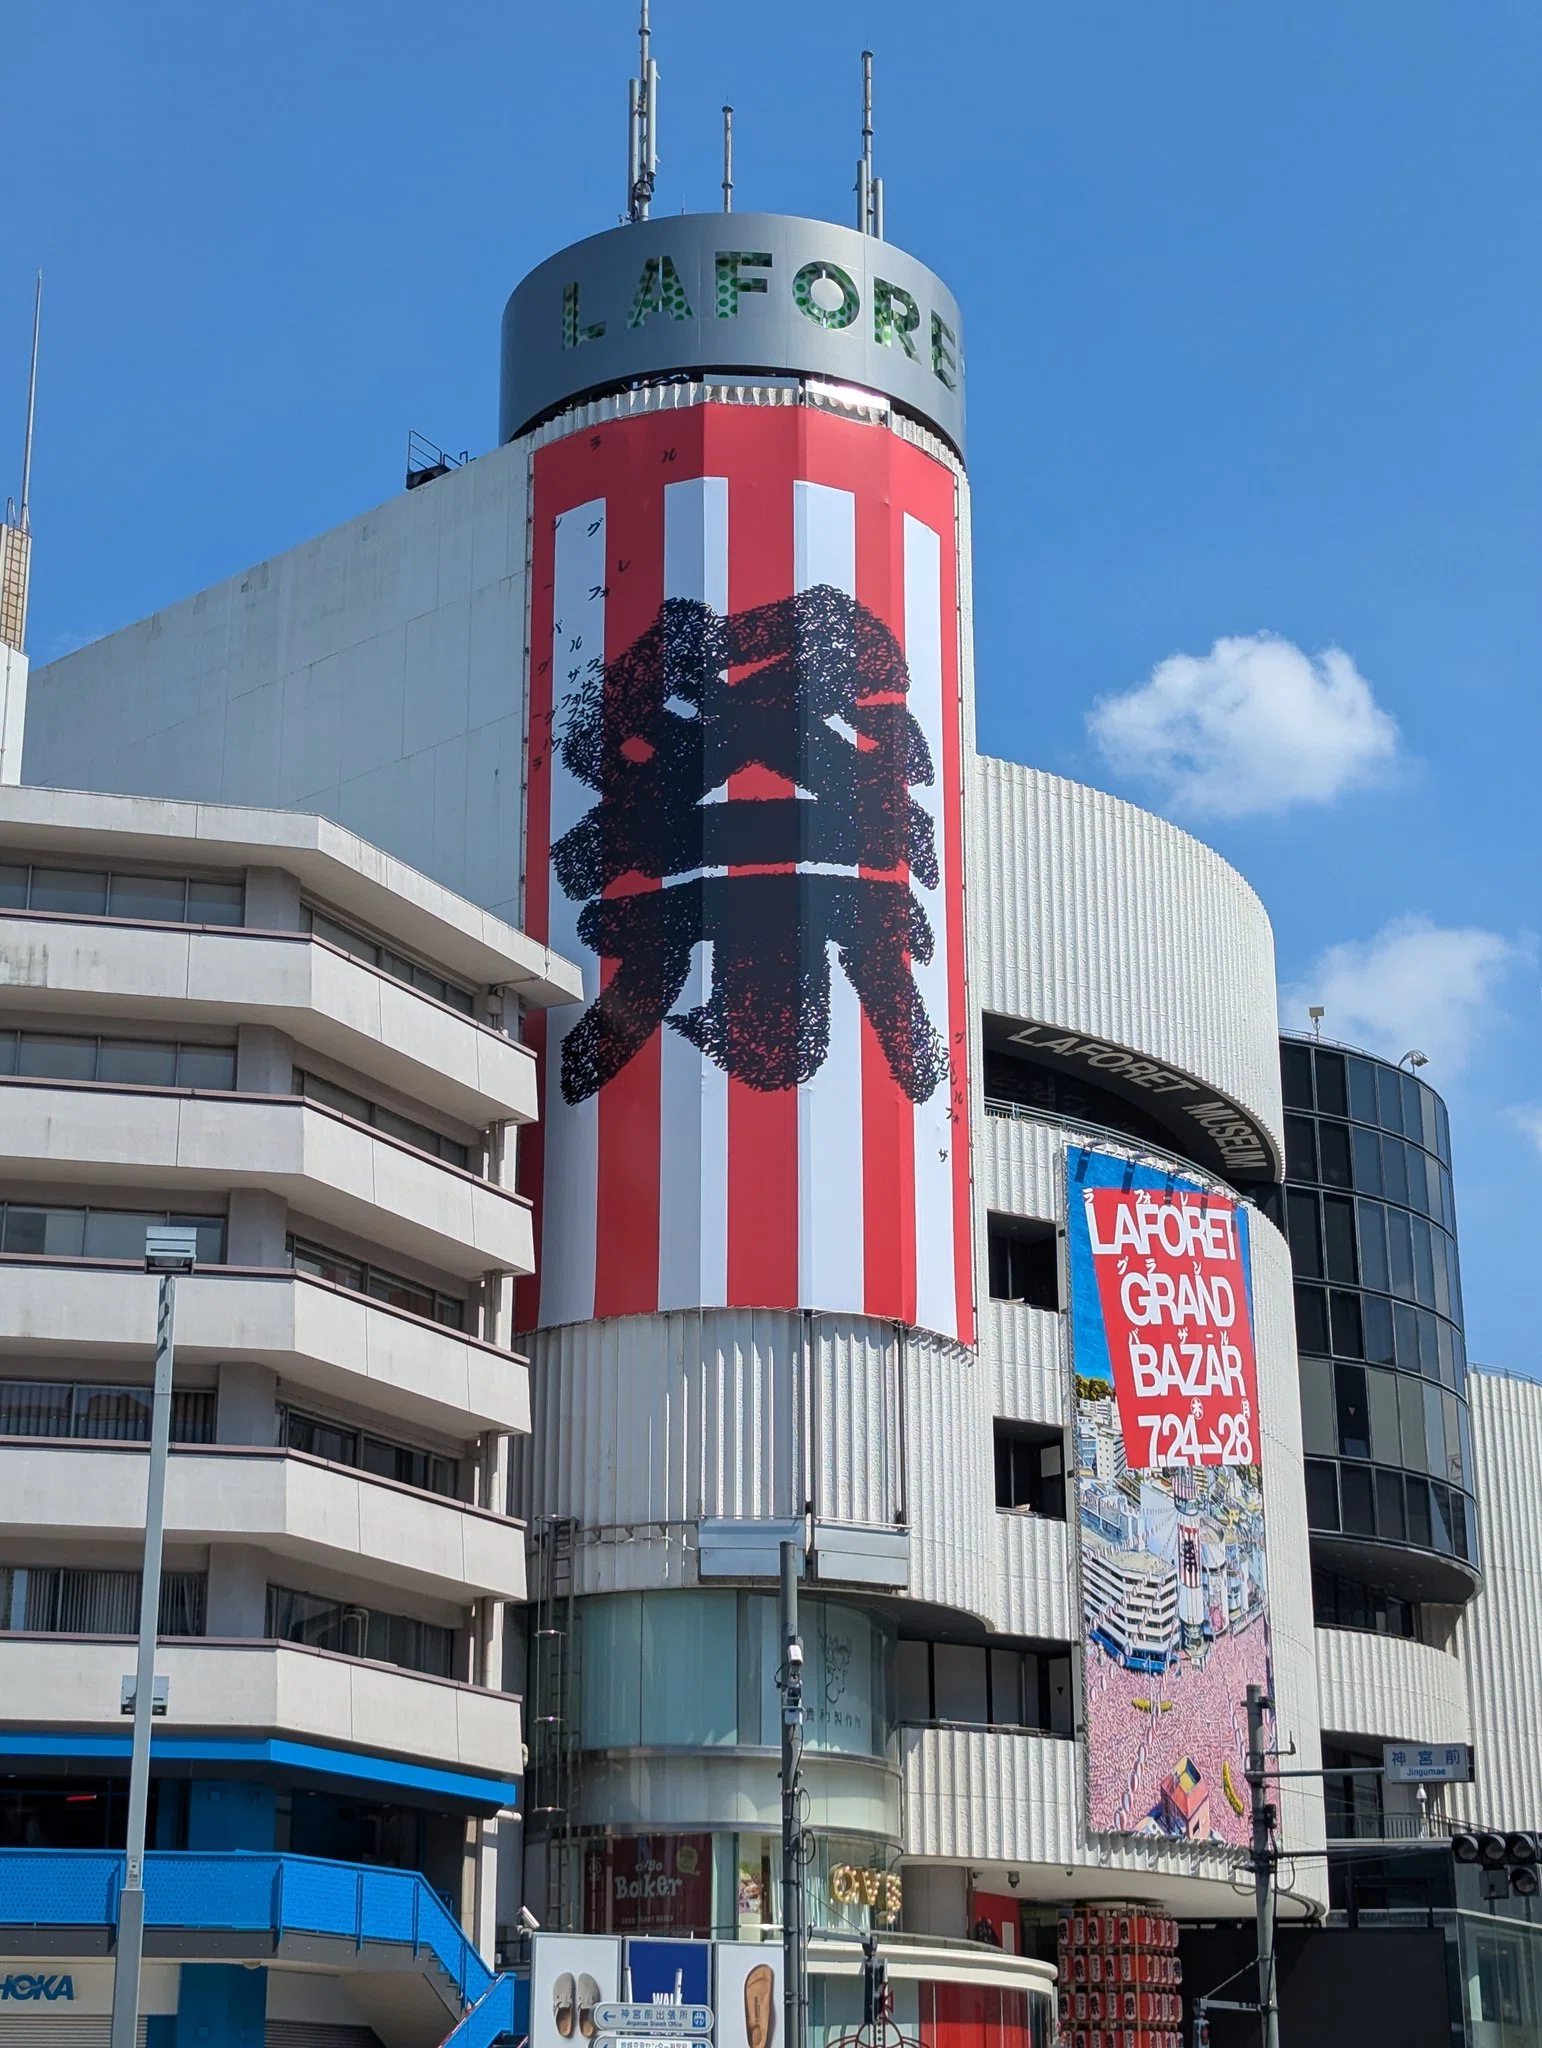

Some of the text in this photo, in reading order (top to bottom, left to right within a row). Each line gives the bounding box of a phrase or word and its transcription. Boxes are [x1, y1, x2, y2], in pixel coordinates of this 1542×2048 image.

[1006, 1026, 1267, 1169] LAFORET MUSEUM
[1085, 1204, 1237, 1261] LAFORET
[1120, 1272, 1235, 1327] GRAND
[1129, 1343, 1246, 1398] BAZAR
[1391, 1748, 1460, 1767] 神宮前
[1406, 1767, 1447, 1778] Jingumae
[0, 1974, 74, 2001] HOKA
[621, 2009, 688, 2020] 神宮前出張所
